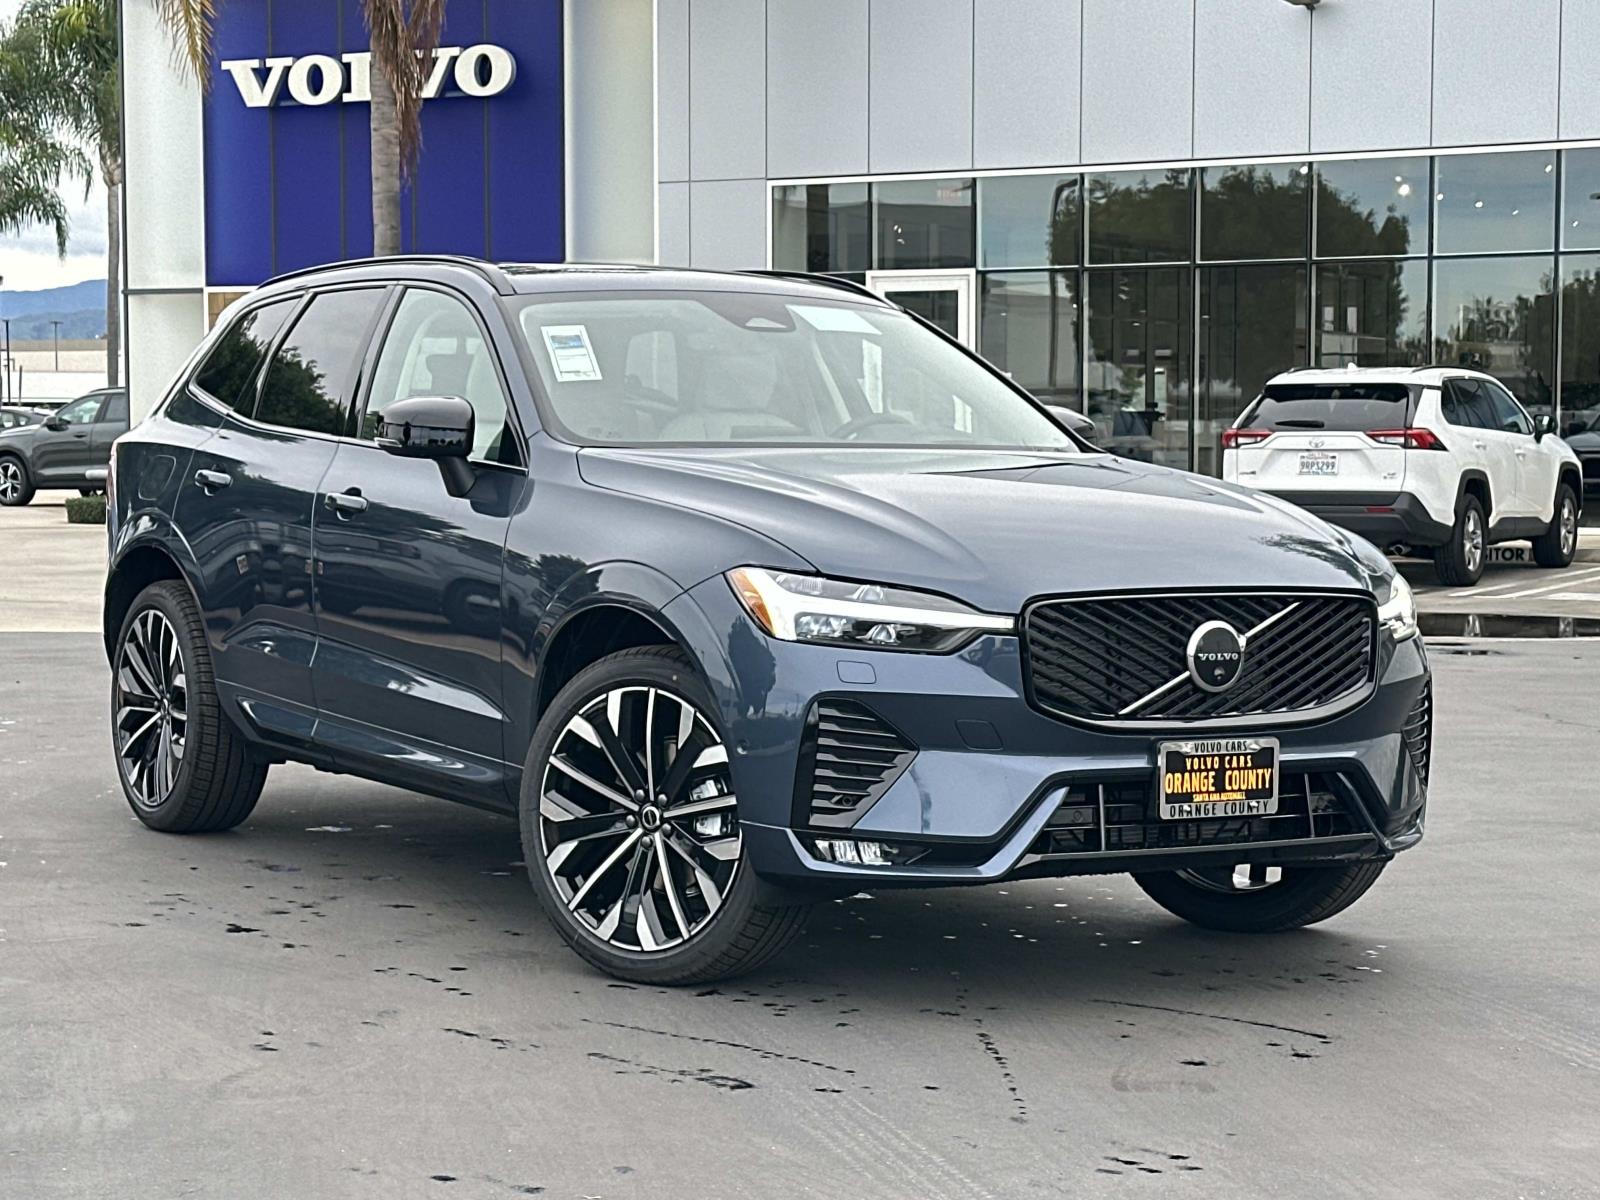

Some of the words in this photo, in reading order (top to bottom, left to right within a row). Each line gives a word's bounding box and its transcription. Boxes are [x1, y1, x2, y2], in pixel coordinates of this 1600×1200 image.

[1485, 548, 1525, 561] ITOR
[1198, 652, 1239, 661] VOLVO
[1194, 742, 1222, 754] VOLVO
[1225, 741, 1248, 752] CARS
[1185, 757, 1220, 770] VOLVO
[1224, 755, 1252, 769] CARS
[1165, 771, 1216, 794] ORANGE
[1225, 768, 1272, 790] COUNTY
[1169, 803, 1217, 818] ORANGE
[1223, 800, 1269, 815] COUNTY
